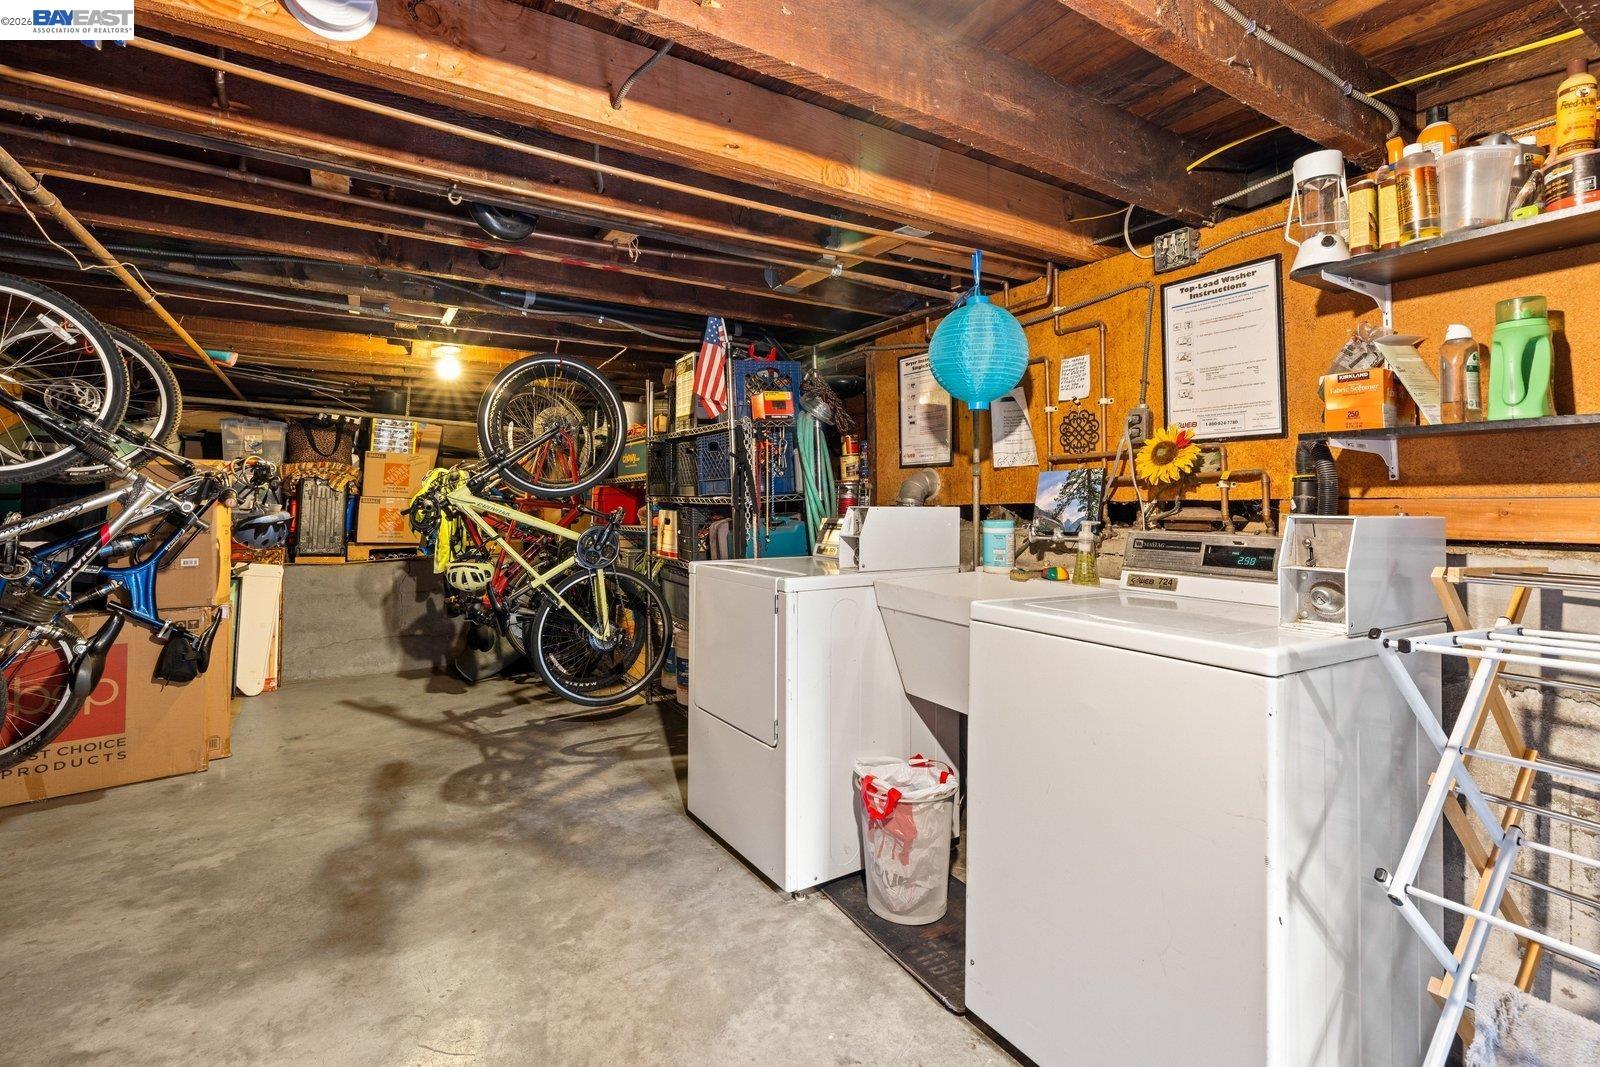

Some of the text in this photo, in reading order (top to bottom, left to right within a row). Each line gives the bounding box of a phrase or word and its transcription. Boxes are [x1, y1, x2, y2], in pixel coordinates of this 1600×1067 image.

[1180, 270, 1258, 294] Top-Load Washer
[1189, 281, 1247, 300] Instructions
[1338, 372, 1369, 380] KIRKLAND
[1350, 384, 1379, 392] Softener
[1347, 410, 1360, 418] 250
[1144, 541, 1165, 549] MAYTAG
[1238, 556, 1257, 566] 2.98
[56, 546, 97, 588] GIANT
[1158, 577, 1173, 586] 724
[565, 680, 597, 688] MAXXIS
[57, 737, 127, 757] CHOICE
[1, 750, 127, 780] PRODUCTS
